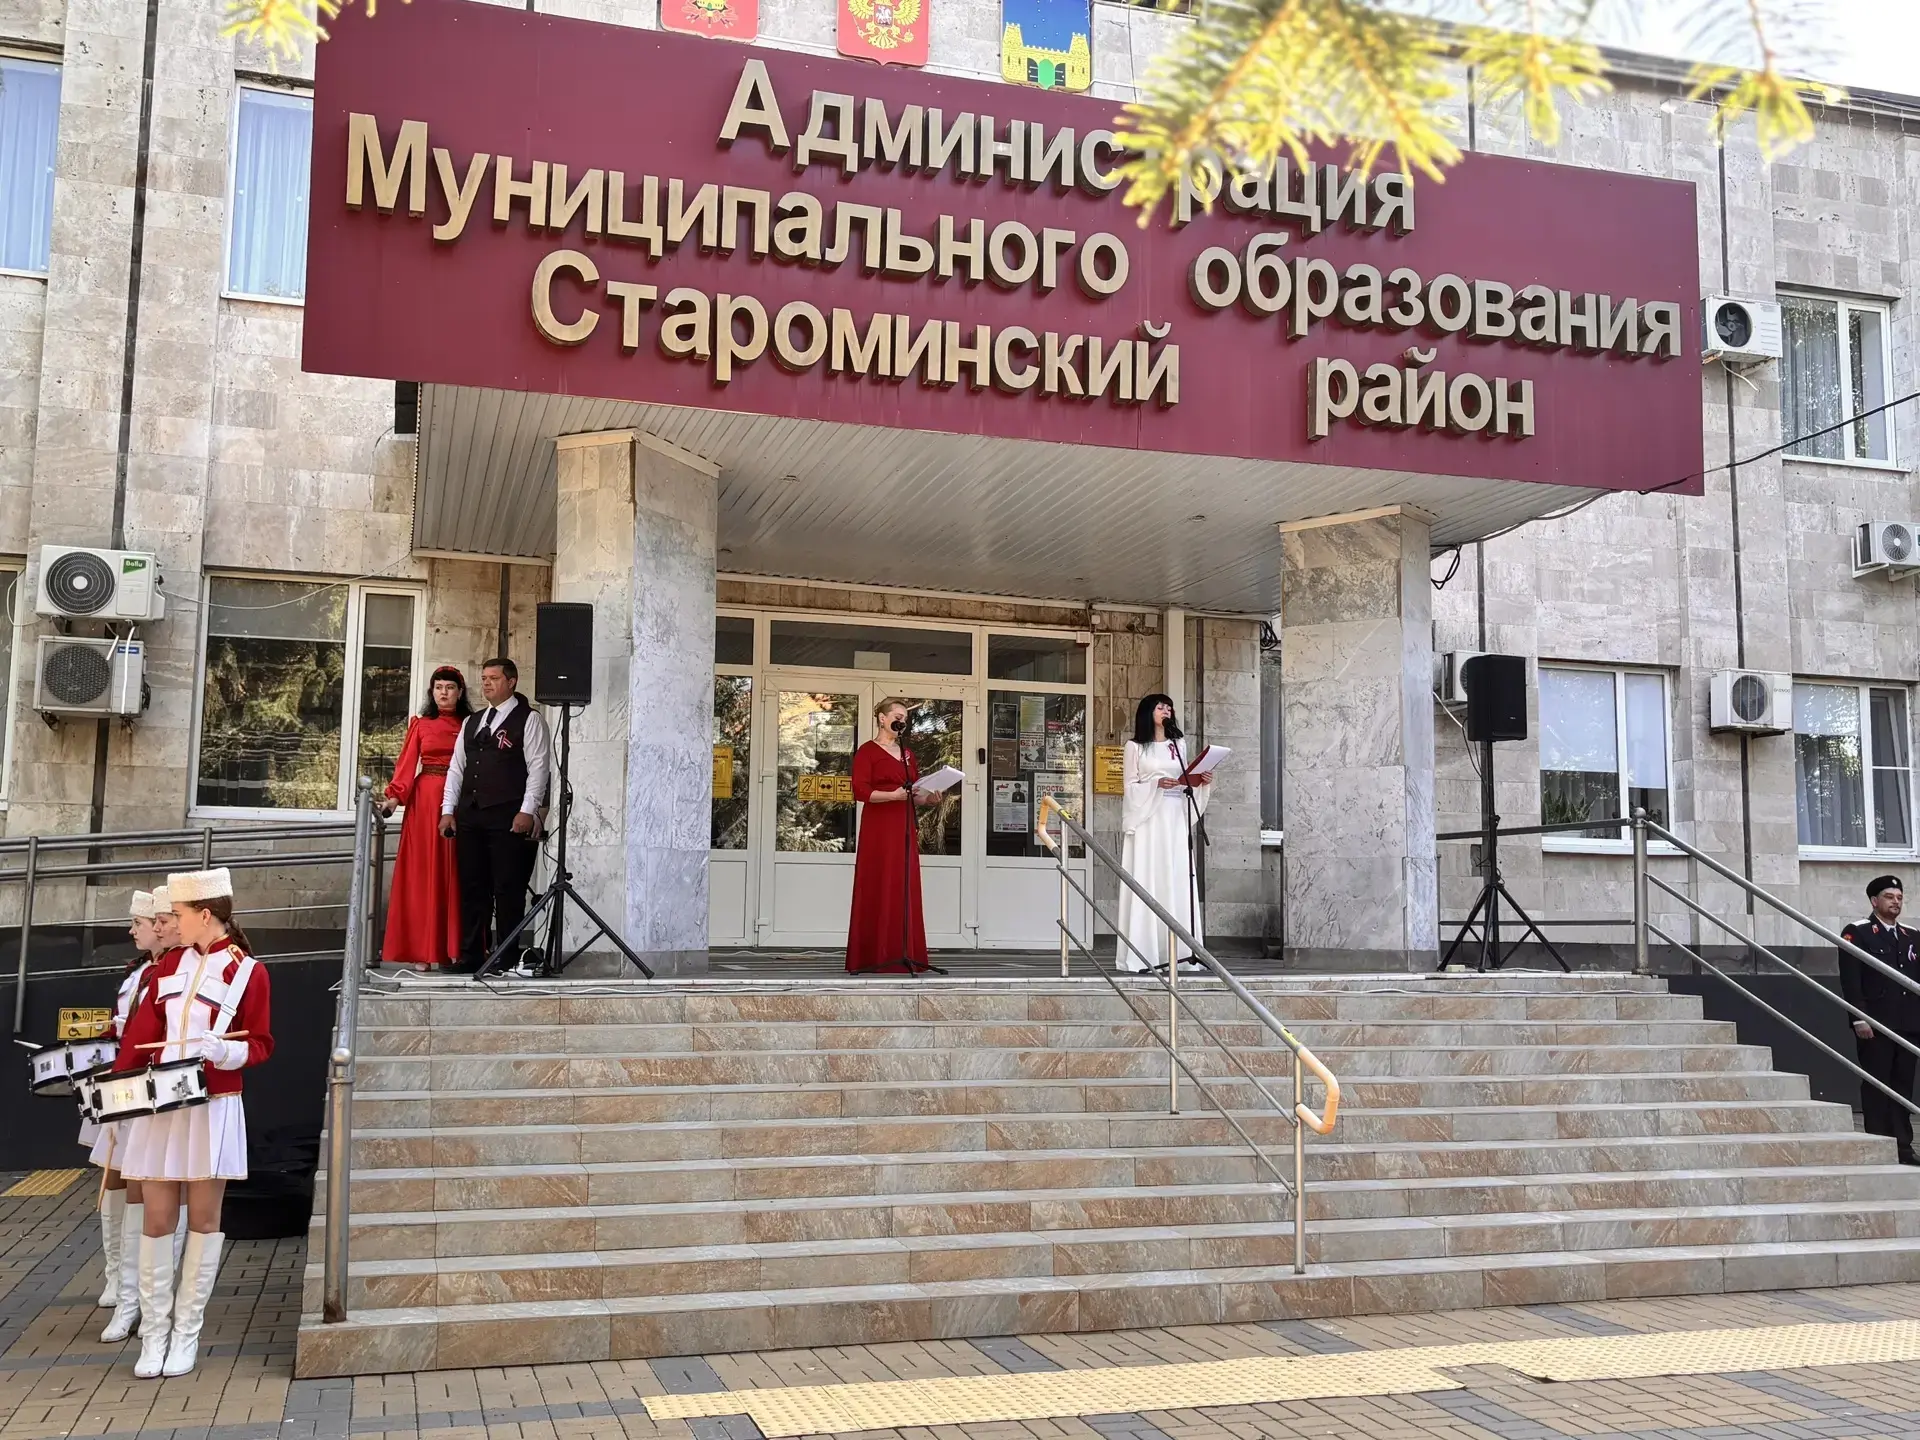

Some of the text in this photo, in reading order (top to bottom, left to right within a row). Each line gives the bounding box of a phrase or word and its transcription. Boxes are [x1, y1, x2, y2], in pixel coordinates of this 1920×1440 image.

[344, 112, 1682, 359] Муниципального образования
[717, 58, 1415, 235] Админисрация
[531, 249, 1536, 440] Староминский район
